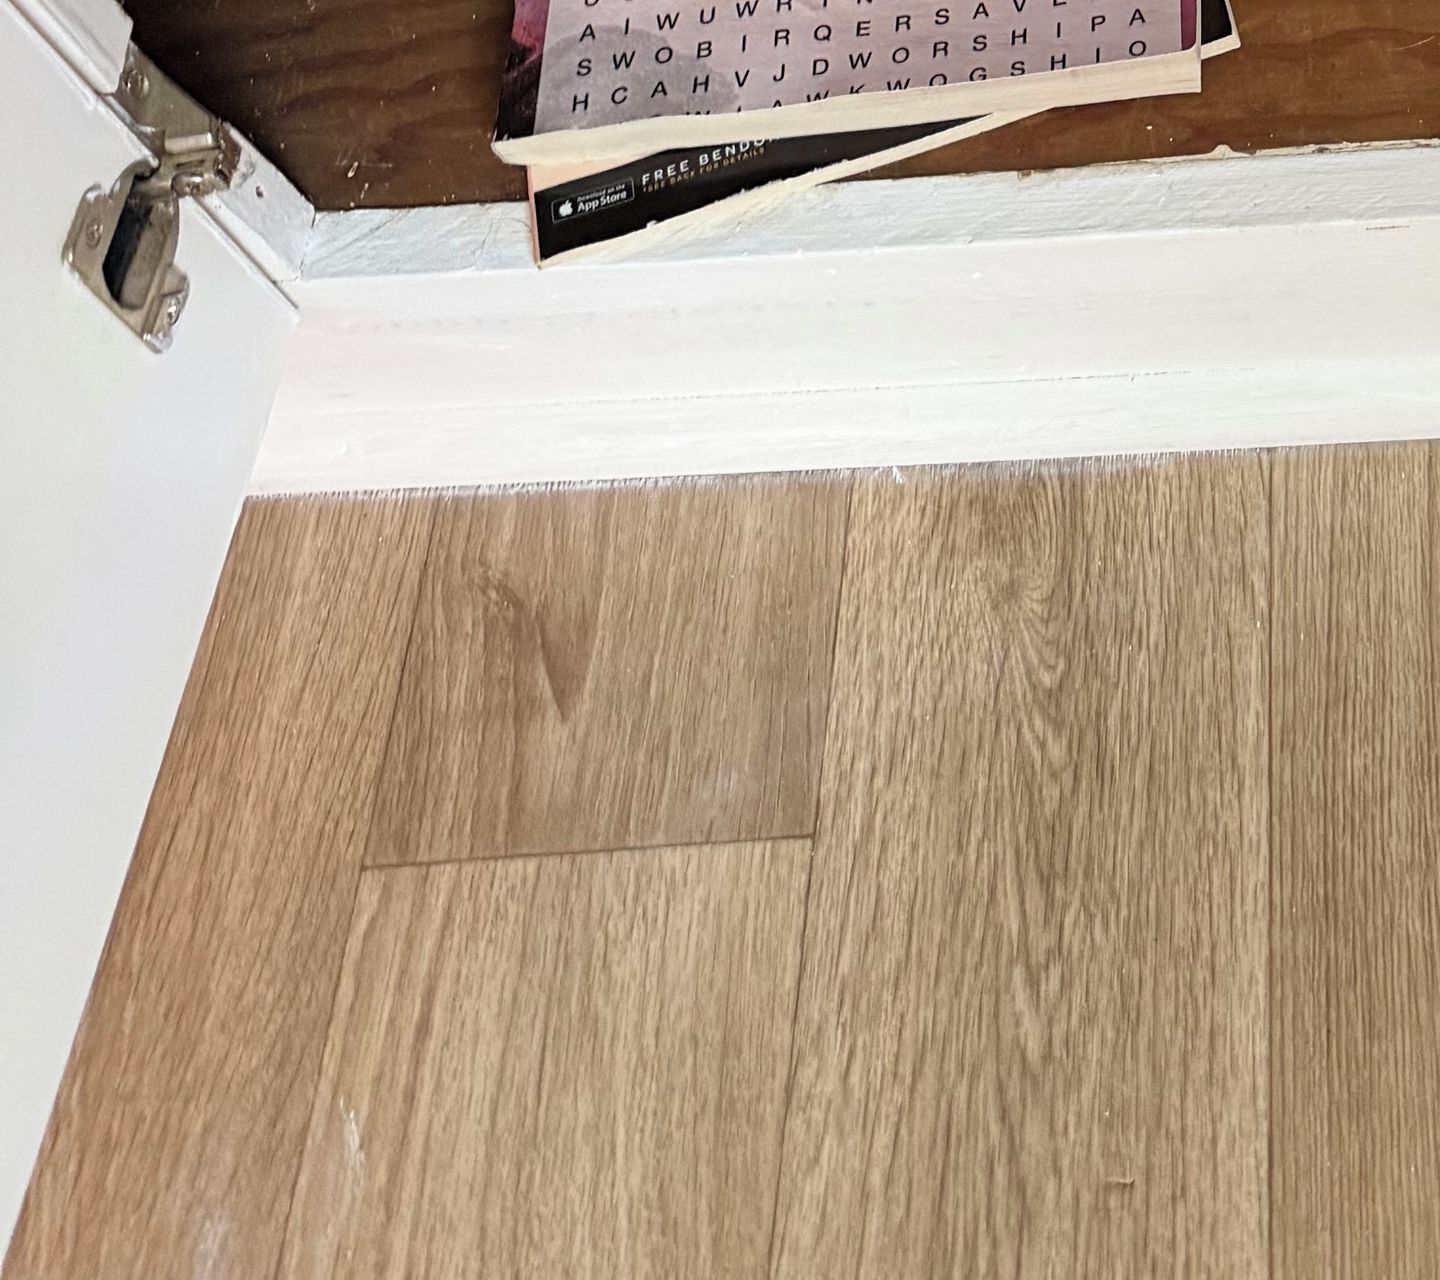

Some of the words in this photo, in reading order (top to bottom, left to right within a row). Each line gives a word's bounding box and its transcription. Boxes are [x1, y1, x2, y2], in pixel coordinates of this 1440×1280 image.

[642, 159, 690, 185] FREE
[699, 139, 773, 166] BENDO
[577, 199, 600, 213] App
[600, 190, 627, 206] Store
